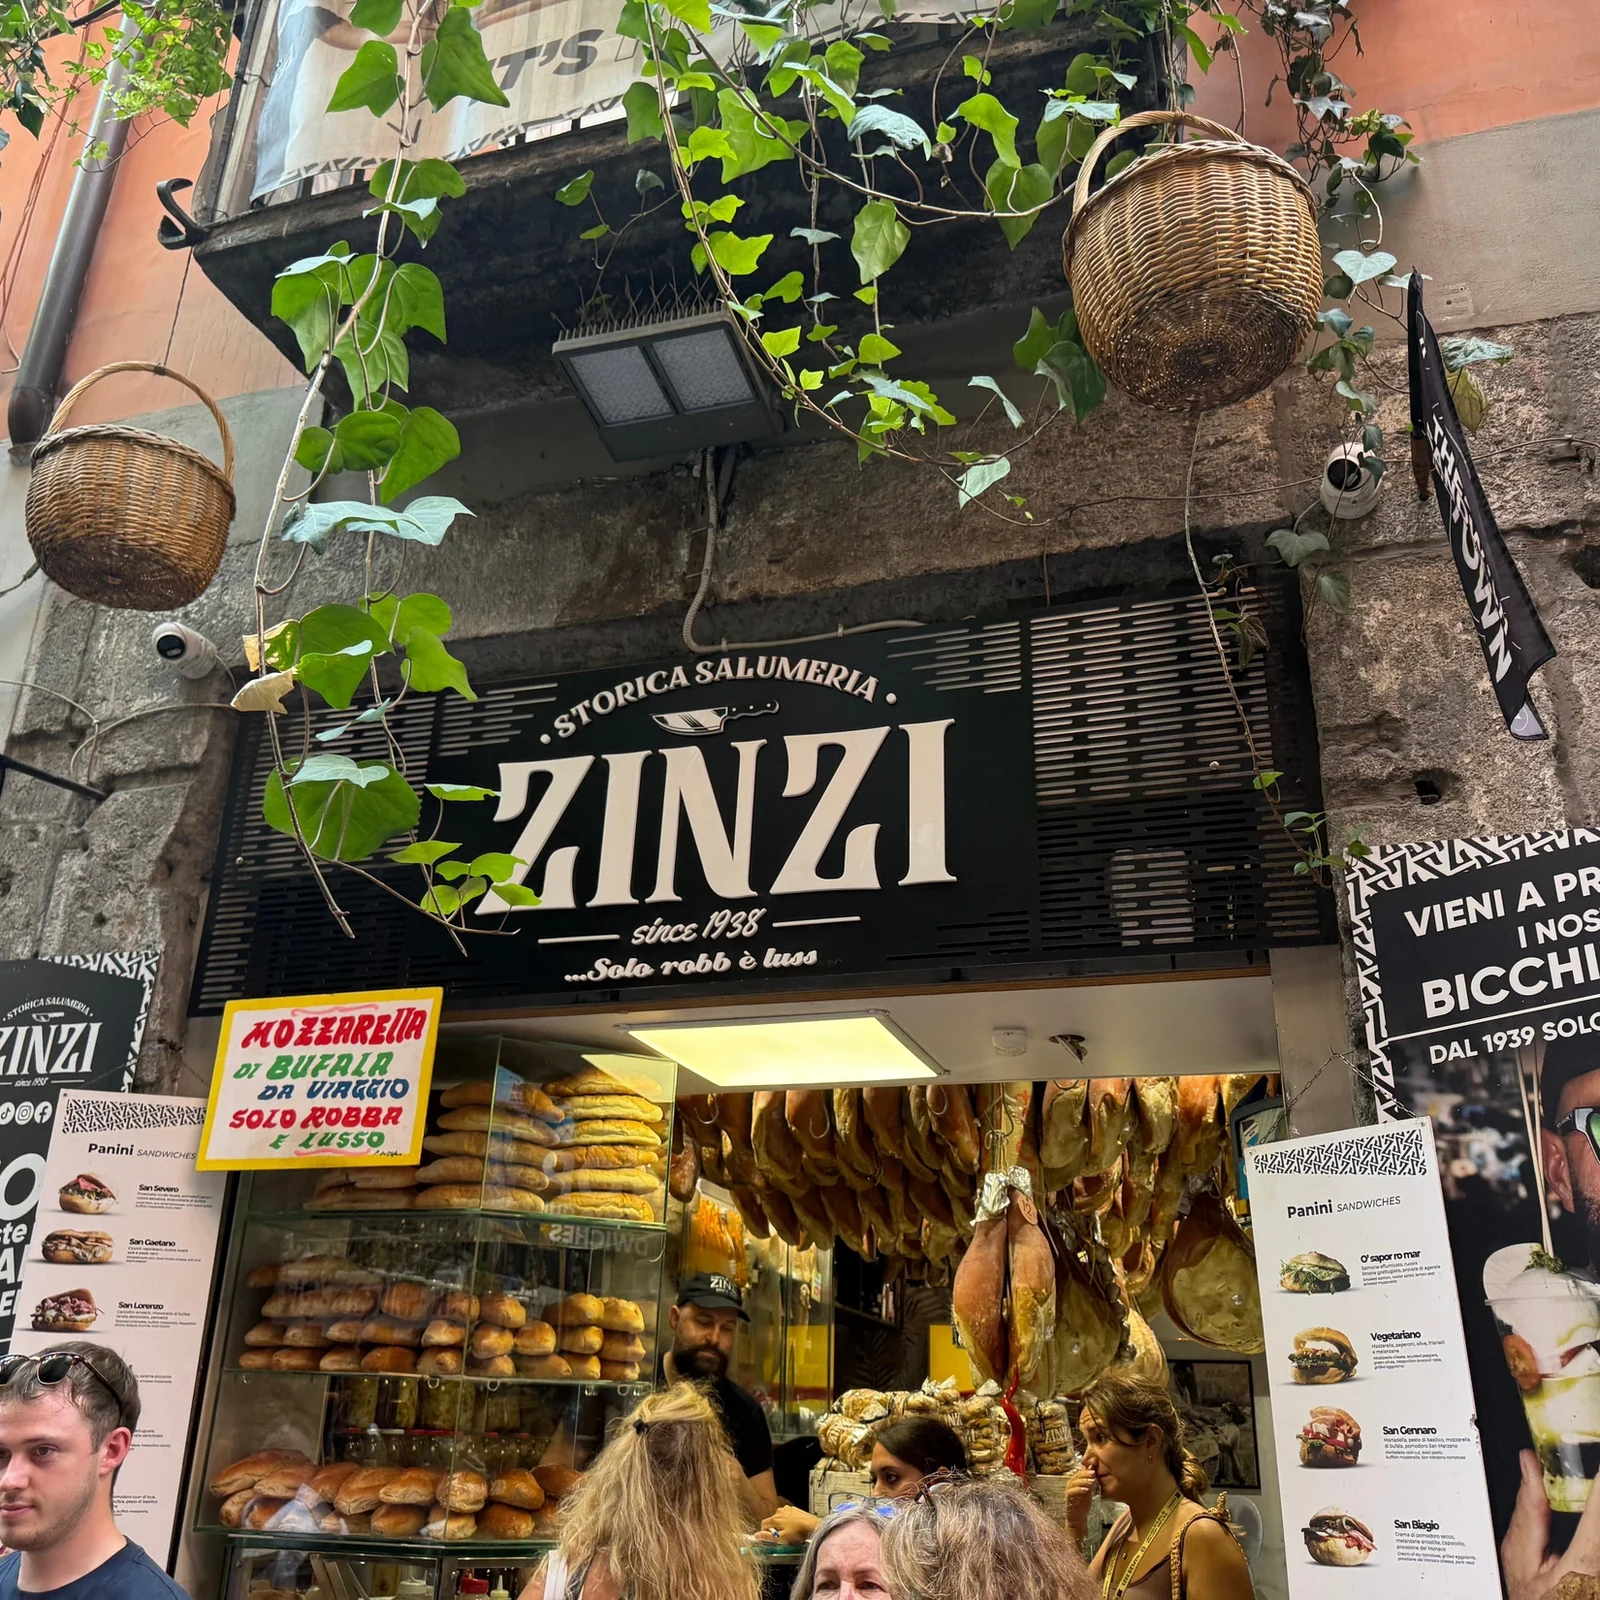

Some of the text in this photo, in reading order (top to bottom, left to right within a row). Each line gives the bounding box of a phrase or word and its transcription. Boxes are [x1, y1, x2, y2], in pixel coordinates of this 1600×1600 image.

[478, 29, 604, 98] T'S
[554, 655, 878, 738] STORICA SALUMERIA
[474, 718, 957, 915] ZINZI
[1404, 889, 1505, 937] VIENI
[1517, 881, 1546, 913] A
[631, 907, 767, 945] since 1938
[1517, 908, 1600, 948] I NOS
[660, 951, 731, 974] robb
[739, 949, 758, 971] è
[763, 948, 818, 970] luss
[1421, 942, 1600, 1019] BICCHI
[7, 997, 89, 1020] STORICA SALUMERIA
[1429, 1039, 1478, 1065] DAL
[1482, 1026, 1535, 1054] 1939
[233, 1051, 394, 1081] DI BUFALA
[257, 1084, 295, 1101] DA
[229, 1106, 403, 1129] SOLO ROBBA
[88, 1143, 197, 1160] Panini SANDWICHES
[269, 1131, 385, 1150] E LUSSO
[0, 1153, 46, 1220] O
[154, 1184, 178, 1192] Severo
[1287, 1195, 1402, 1218] Panini SANDWICHES
[0, 1222, 28, 1245] te
[145, 1238, 175, 1246] Gaetano
[1360, 1254, 1368, 1263] O'
[1370, 1253, 1392, 1264] sapor
[1403, 1250, 1420, 1258] mar
[133, 1301, 163, 1310] Lorenzo
[1370, 1329, 1421, 1342] Vegetariano
[1382, 1426, 1436, 1434] San Gennaro
[1394, 1518, 1439, 1532] San Biagio
